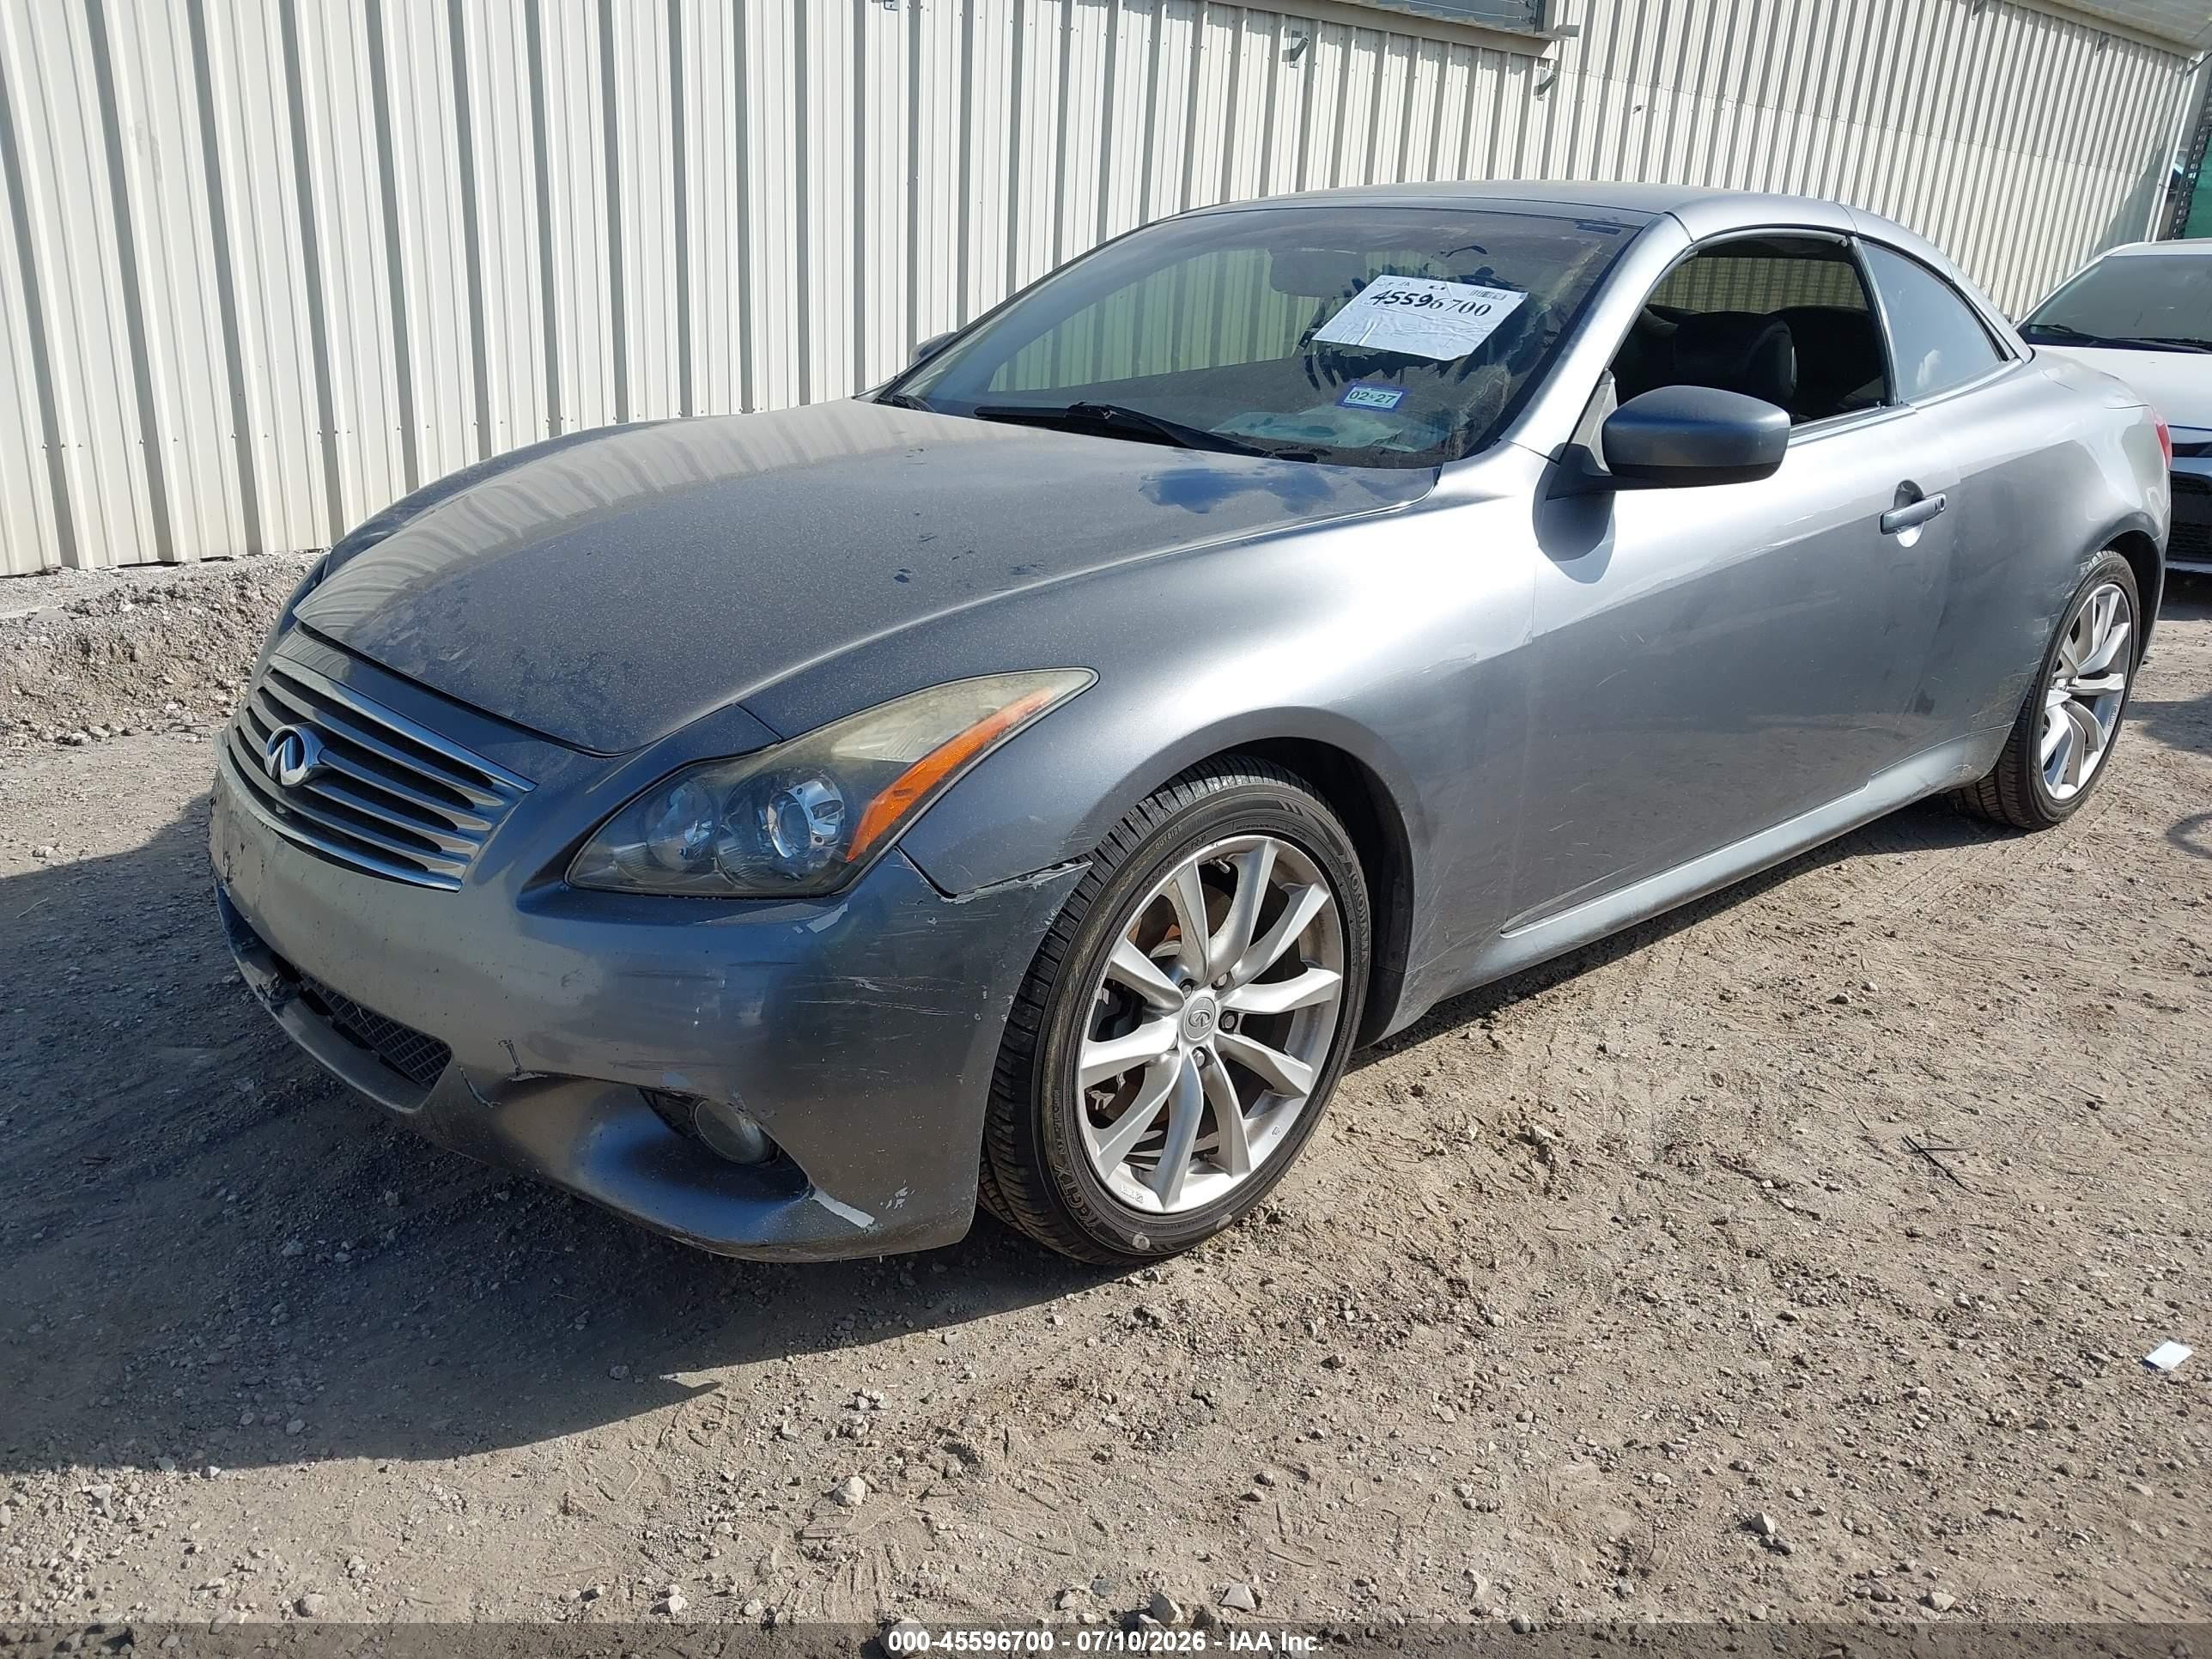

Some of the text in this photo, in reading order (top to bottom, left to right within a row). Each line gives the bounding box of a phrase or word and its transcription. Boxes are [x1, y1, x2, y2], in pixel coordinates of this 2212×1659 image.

[1370, 289, 1492, 317] 45596700
[1349, 391, 1396, 404] 02 27
[1348, 867, 1370, 963] YOKOHAMA
